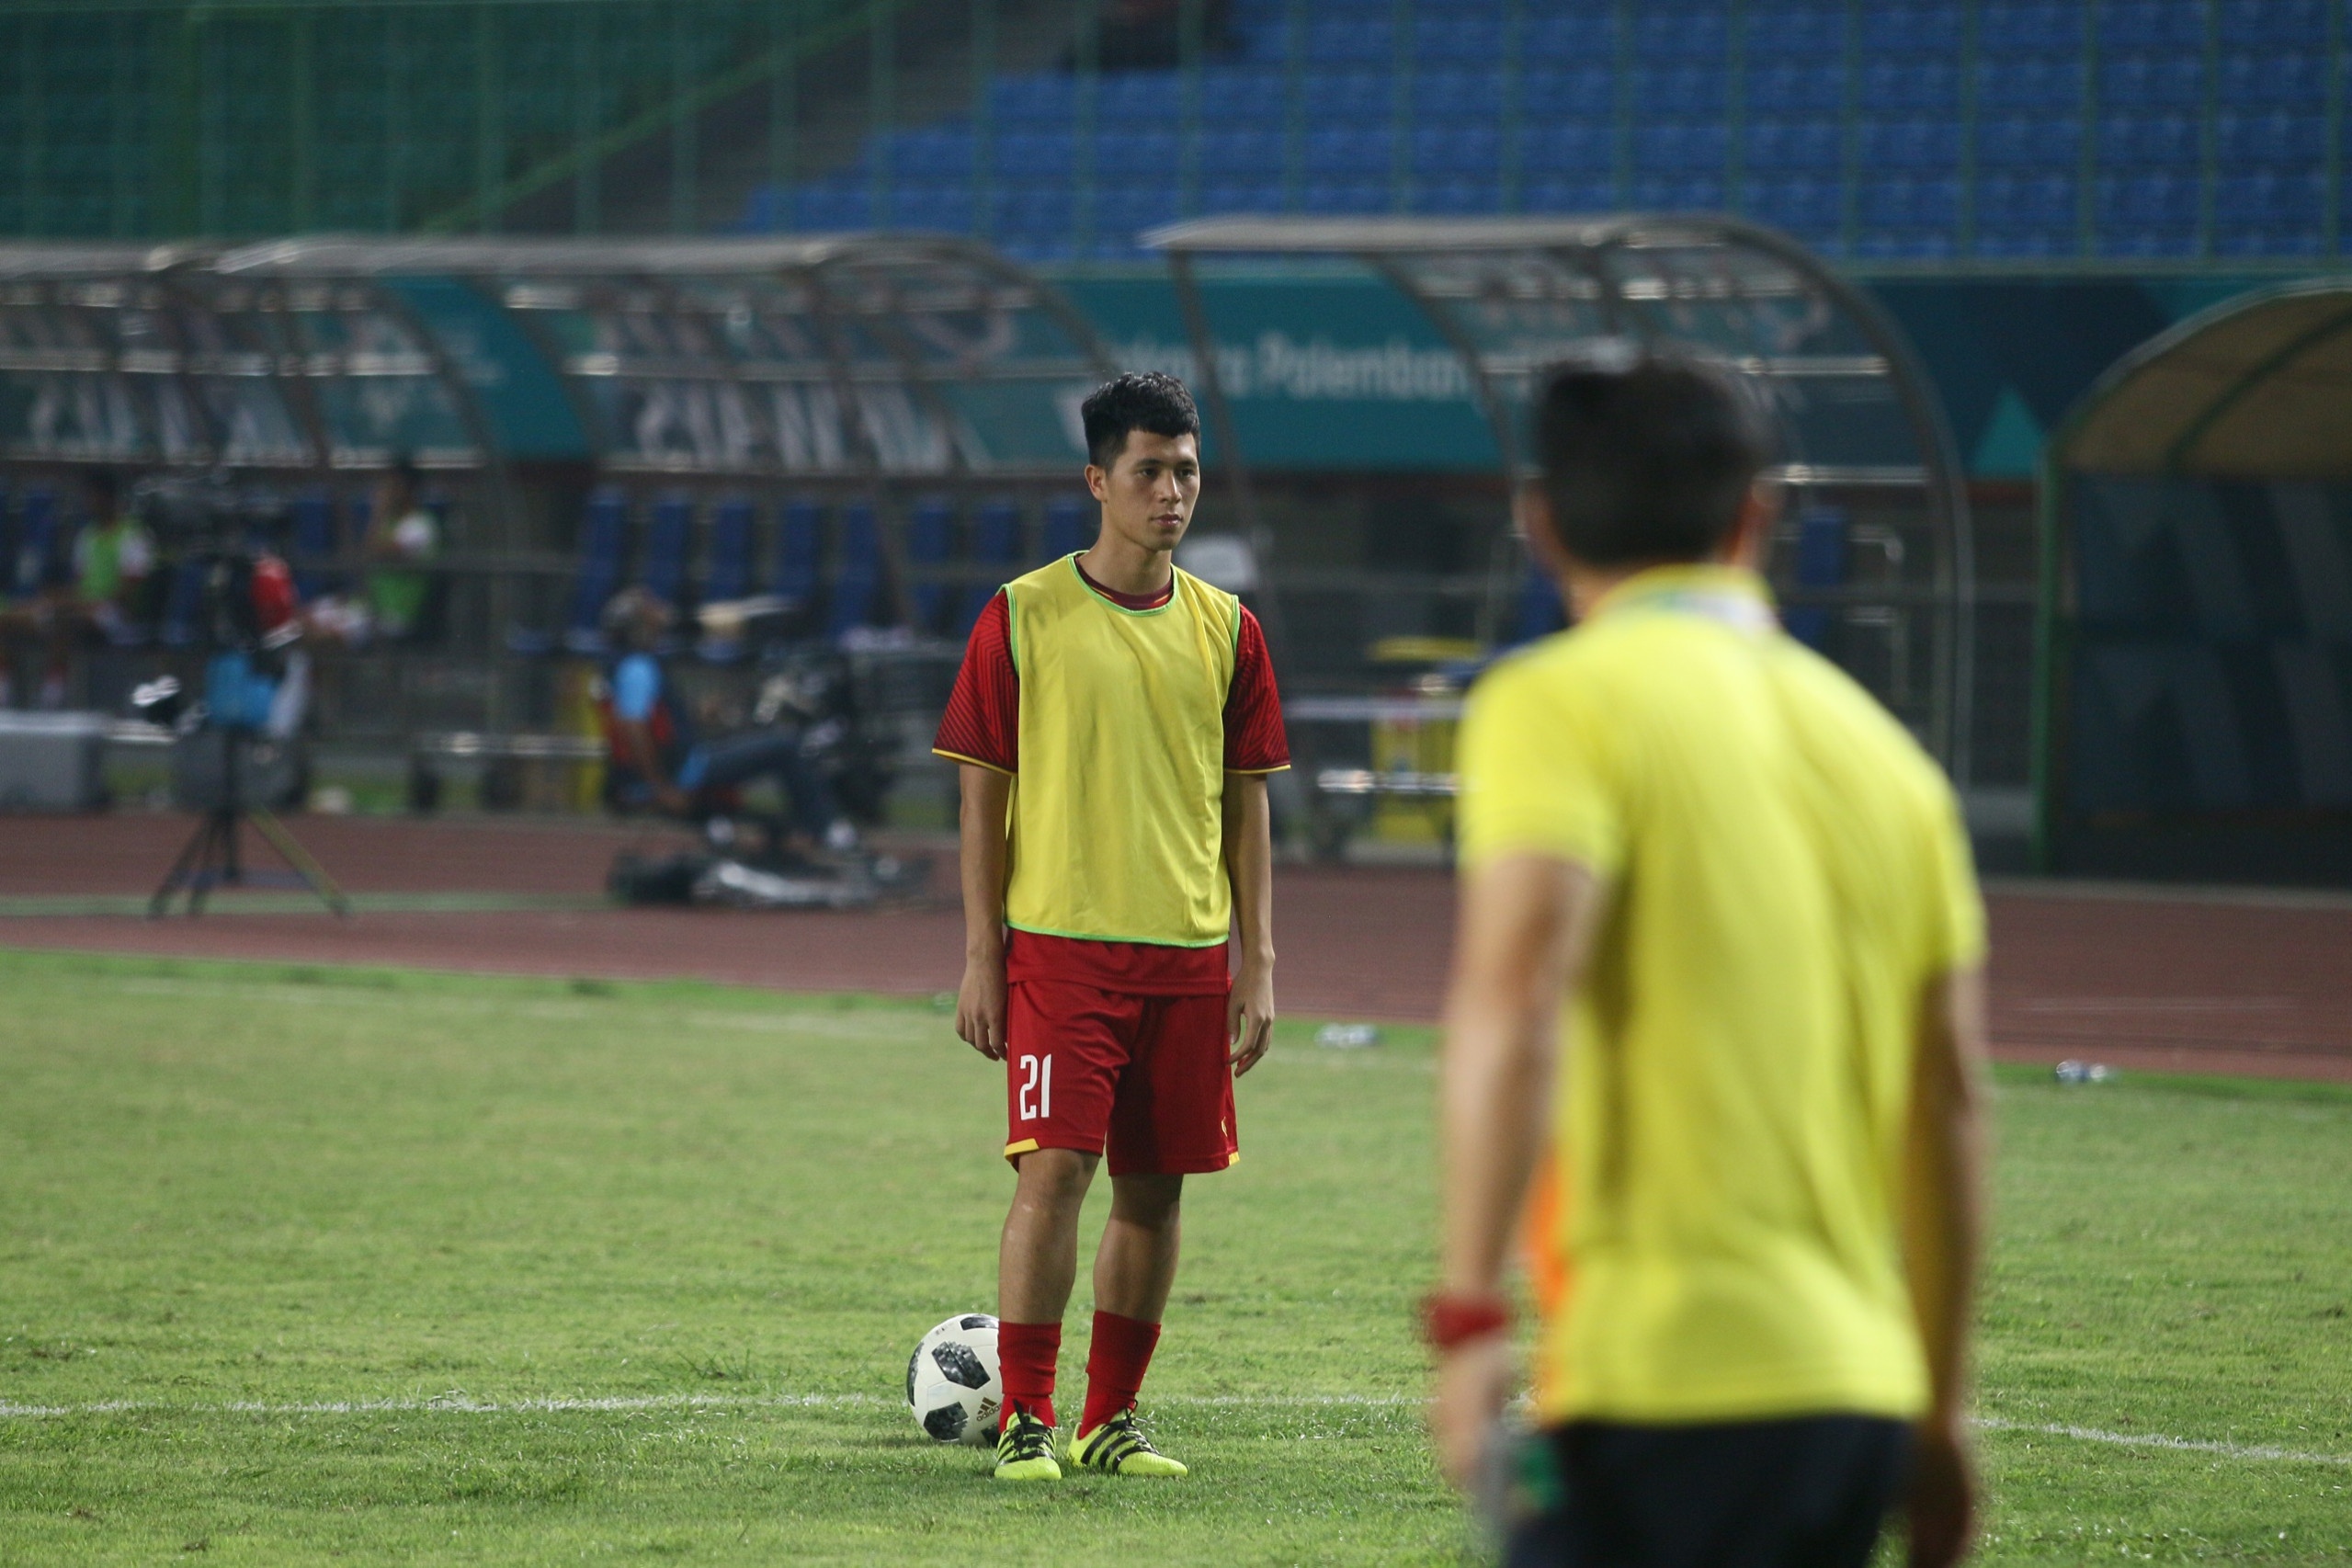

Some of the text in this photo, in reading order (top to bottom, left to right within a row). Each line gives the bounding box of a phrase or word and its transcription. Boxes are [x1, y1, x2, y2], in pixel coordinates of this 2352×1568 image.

[1256, 332, 1474, 401] Palemban
[1019, 1053, 1051, 1120] 21
[976, 1403, 1002, 1422] adida
